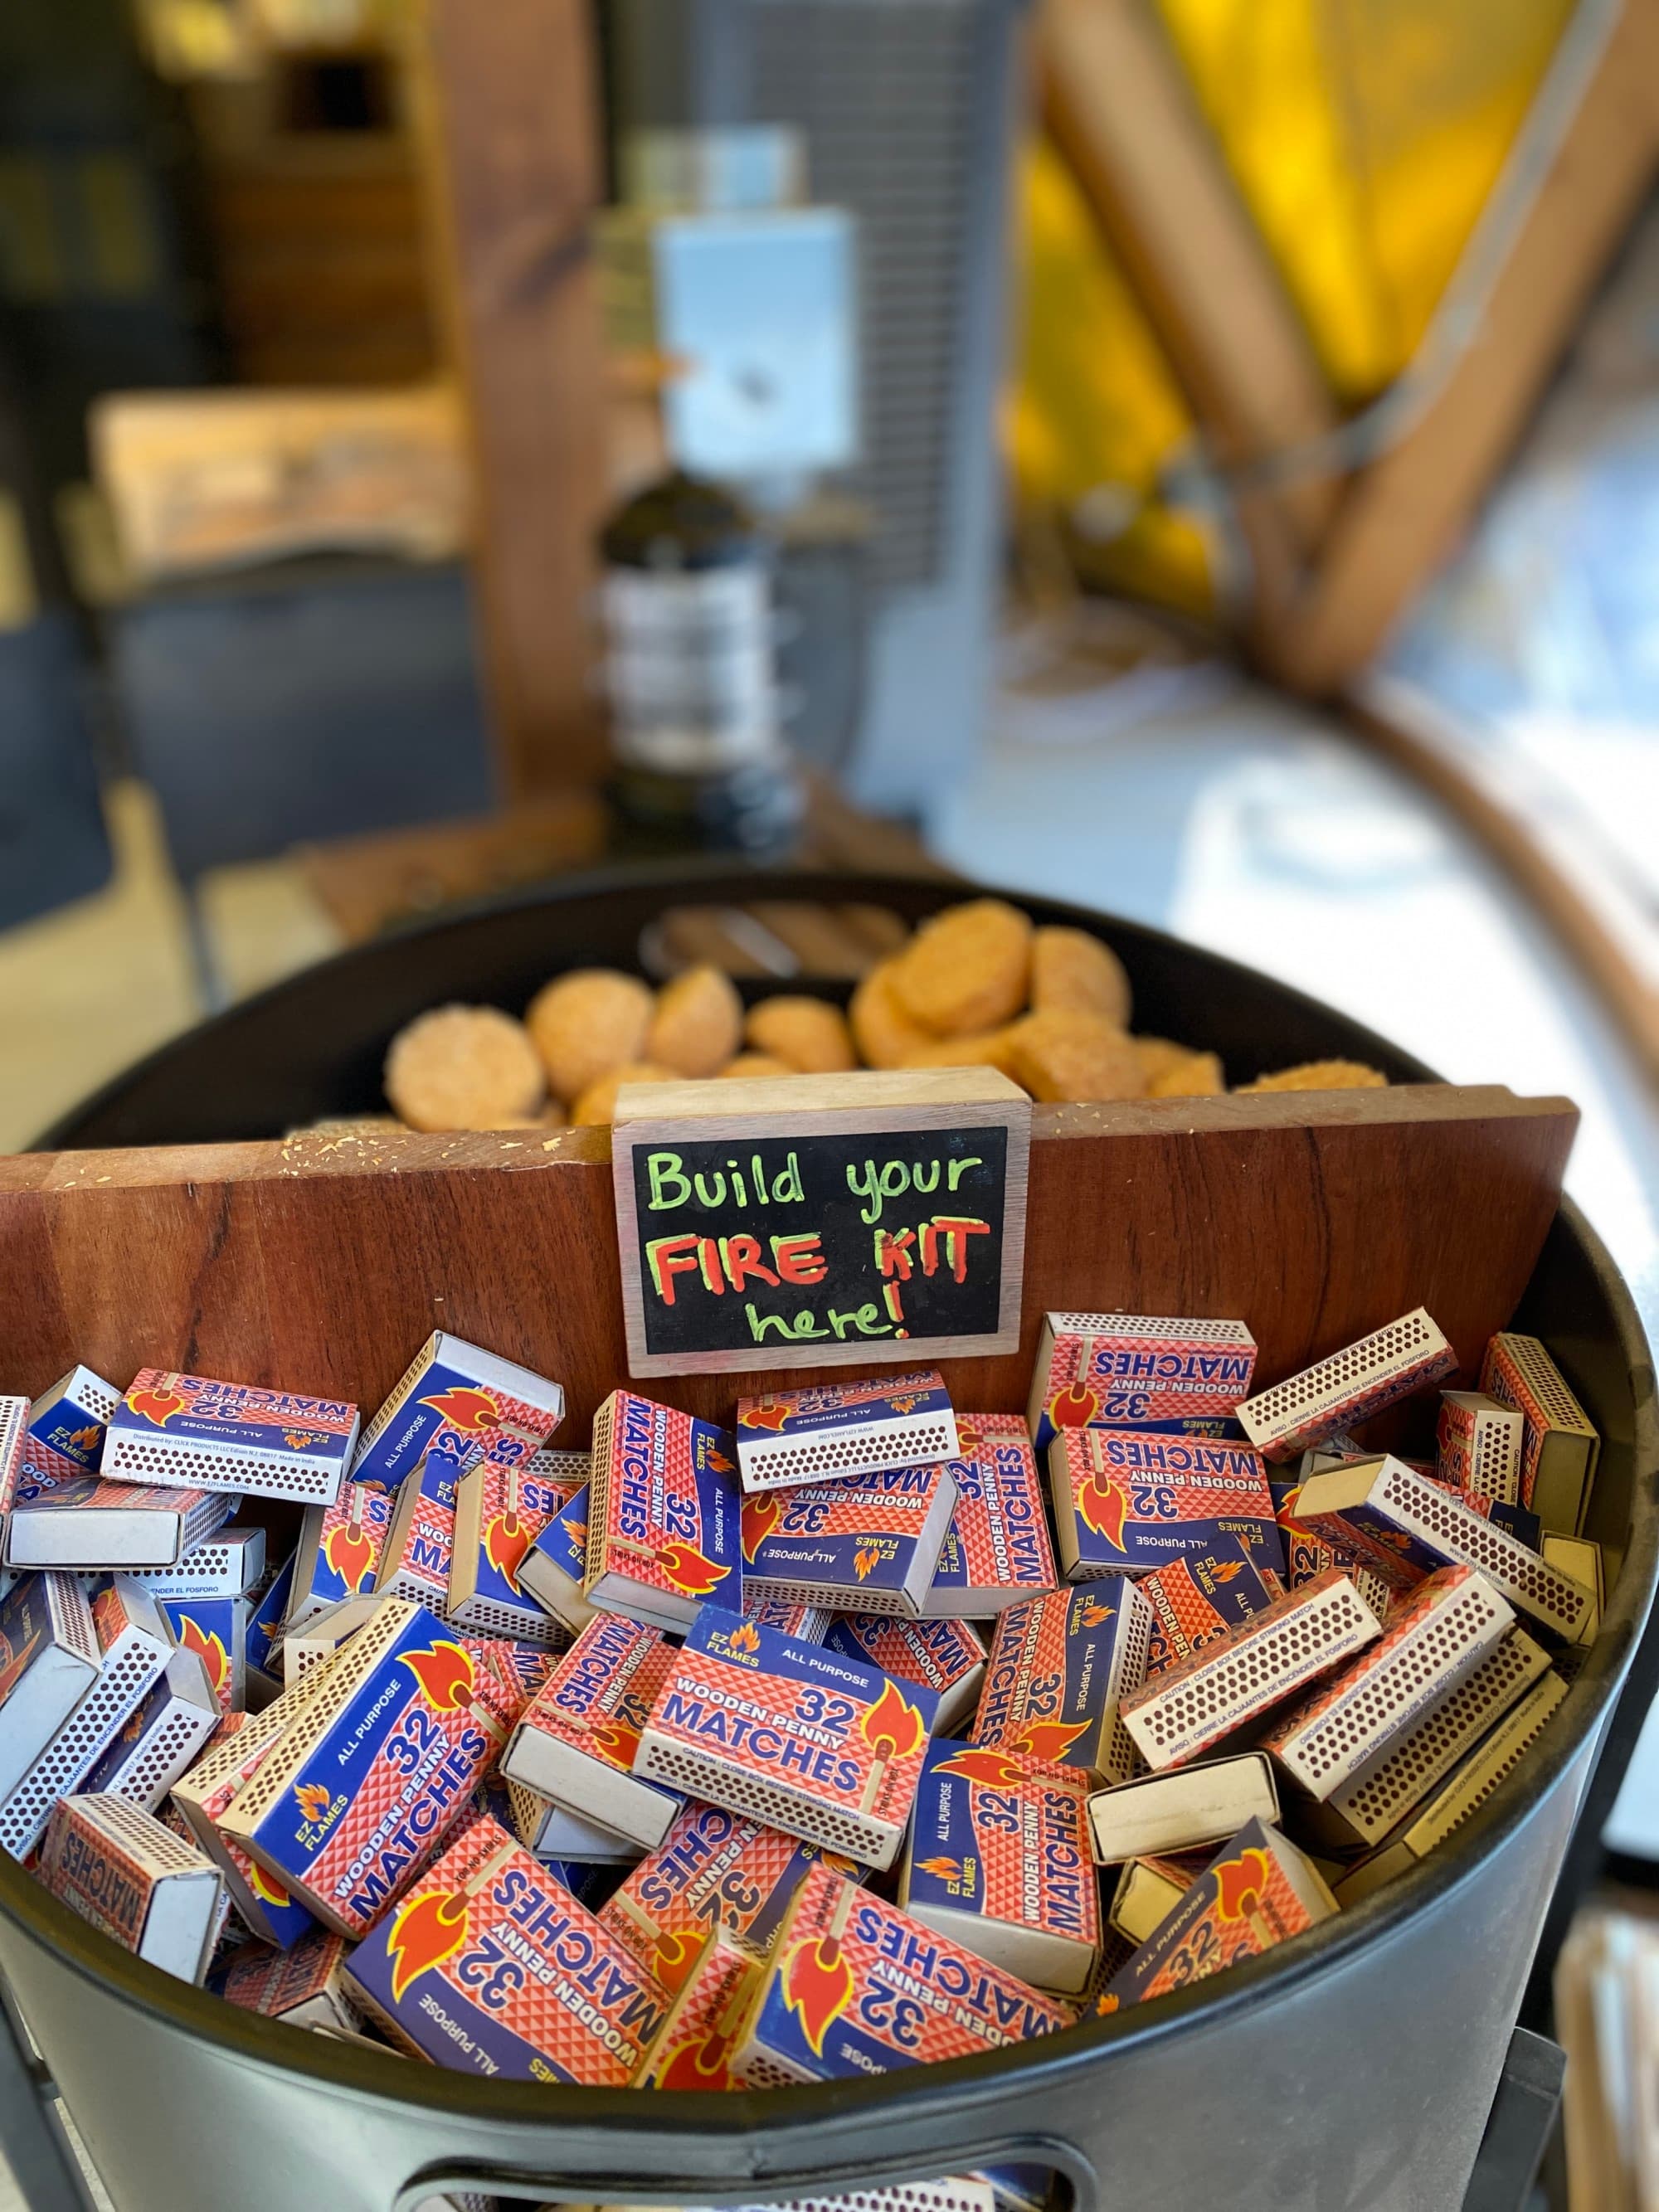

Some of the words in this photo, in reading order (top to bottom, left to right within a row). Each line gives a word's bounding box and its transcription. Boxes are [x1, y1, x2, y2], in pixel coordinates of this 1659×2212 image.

[647, 1151, 805, 1210] Build
[846, 1157, 983, 1224] your
[645, 1232, 828, 1305] FIRE
[873, 1216, 990, 1283] KIT
[746, 1281, 909, 1342] here!
[778, 1370, 932, 1399] MATCHES
[1095, 1352, 1251, 1380] MATCHES
[182, 1378, 348, 1417] MATCHES
[200, 1393, 260, 1410] PENNY
[1110, 1379, 1166, 1391] PENNY
[1171, 1381, 1243, 1394] WOODEN
[191, 1401, 245, 1420] 32
[262, 1403, 345, 1423] WOODEN
[795, 1396, 844, 1412] 32
[795, 1412, 848, 1425] PURPOSE
[1104, 1392, 1151, 1418] 32
[55, 1426, 71, 1438] EZ
[180, 1421, 237, 1434] PURPOSE
[281, 1428, 330, 1437] FLAMES
[385, 1451, 398, 1468] ALL
[395, 1414, 426, 1452] PURPOSE
[706, 1436, 715, 1449] EZ
[1183, 1420, 1225, 1429] FLAMES
[1209, 1430, 1223, 1438] EZ
[47, 1433, 90, 1463] FLAMES
[653, 1410, 667, 1477] WOODEN
[697, 1433, 705, 1471] FLAMES
[1106, 1440, 1259, 1475] MATCHES
[440, 1481, 453, 1491] EZ
[620, 1398, 651, 1539] MATCHES
[1130, 1471, 1186, 1485] PENNY
[1190, 1475, 1262, 1491] WOODEN
[650, 1477, 663, 1529] PENNY
[714, 1488, 724, 1510] ALL
[795, 1489, 849, 1502] PENNY
[852, 1494, 922, 1509] WOODEN
[982, 1464, 1001, 1511] PENNY
[1129, 1485, 1179, 1518] 32
[665, 1493, 697, 1539] 32
[714, 1511, 724, 1554] PURPOSE
[783, 1503, 830, 1532] 32
[996, 1446, 1044, 1582] MATCHES
[1219, 1521, 1262, 1533] FLAMES
[767, 1548, 817, 1561] PURPOSE
[817, 1552, 836, 1563] ALL
[855, 1537, 898, 1549] FLAMES
[880, 1550, 895, 1559] EZ
[950, 1533, 961, 1573] FLAMES
[990, 1511, 1010, 1582] WOODEN
[1136, 1535, 1186, 1547] PURPOSE
[1249, 1534, 1263, 1544] EZ
[939, 1556, 949, 1573] EZ
[1194, 1562, 1216, 1596] FLAMES
[1205, 1556, 1215, 1568] EZ
[1069, 1597, 1084, 1636] FLAMES
[1086, 1594, 1095, 1607] EZ
[1146, 1577, 1177, 1636] WOODEN
[1235, 1592, 1249, 1610] ALL
[711, 1631, 729, 1643] EZ
[1021, 1602, 1045, 1668] WOODEN
[1158, 1680, 1191, 1704] CAUTION
[1192, 1663, 1217, 1682] CLOSE
[1215, 1653, 1233, 1668] BOX
[1230, 1636, 1260, 1658] BEFORE
[1258, 1617, 1291, 1641] STRIKING
[1289, 1602, 1316, 1621] MATCH
[1455, 1639, 1484, 1668] CAUTION
[556, 1621, 635, 1714] MATCHES
[617, 1636, 654, 1680] WOODEN
[707, 1641, 760, 1668] FLAMES
[782, 1649, 805, 1665] ALL
[810, 1659, 869, 1688] PURPOSE
[903, 1629, 944, 1689] WOODEN
[1081, 1644, 1095, 1665] ALL
[980, 1605, 1029, 1748] MATCHES
[1010, 1668, 1031, 1722] PENNY
[1076, 1664, 1092, 1711] PURPOSE
[1167, 1738, 1190, 1756] AVISO
[1192, 1719, 1219, 1740] CIERRE
[1216, 1714, 1228, 1724] LA
[1267, 1681, 1279, 1694] DE
[1277, 1659, 1316, 1686] ENCENDER
[1314, 1653, 1326, 1664] EL
[1323, 1632, 1359, 1658] FOSFORO
[1418, 1686, 1434, 1703] BOX
[1431, 1666, 1454, 1690] CLOSE
[597, 1678, 627, 1715] PENNY
[615, 1694, 650, 1731] 32
[676, 1677, 767, 1722] WOODEN
[772, 1715, 845, 1751] PENNY
[795, 1689, 856, 1736] 32
[1024, 1674, 1061, 1719] 32
[1394, 1698, 1421, 1725] BEFORE
[337, 1743, 358, 1767] ALL
[355, 1678, 402, 1738] PURPOSE
[1366, 1720, 1397, 1751] STRIKING
[14, 1834, 32, 1857] AVISO
[88, 1743, 100, 1757] DE
[95, 1706, 129, 1745] ENCENDER
[124, 1696, 135, 1709] EL
[130, 1665, 159, 1699] FOSFORO
[386, 1708, 441, 1777] 32
[663, 1694, 861, 1792] MATCHES
[1345, 1747, 1370, 1772] MATCH
[334, 1805, 405, 1899] WOODEN
[403, 1732, 451, 1806] PENNY
[937, 1782, 952, 1821] PURPOSE
[978, 1791, 1020, 1834] 32
[294, 1824, 314, 1844] EZ
[304, 1793, 349, 1853] FLAMES
[348, 1728, 487, 1921] MATCHES
[937, 1824, 949, 1841] ALL
[1024, 1801, 1040, 1850] PENNY
[476, 1833, 503, 1858] STRIKE
[1045, 1792, 1082, 1932] MATCHES
[61, 1830, 143, 1932] MATCHES
[453, 1866, 470, 1883] BOX
[686, 1839, 745, 1911] PENNY
[947, 1881, 960, 1894] EZ
[962, 1857, 976, 1898] FLAMES
[1024, 1853, 1040, 1921] WOODEN
[1135, 1952, 1156, 1976] ALL
[1157, 1891, 1206, 1952] PURPOSE
[490, 1920, 558, 1986] PENNY
[493, 1869, 665, 2046] MATCHES
[1169, 1920, 1219, 1987] 32
[457, 1934, 525, 2010] 32
[872, 1958, 951, 2011] PENNY
[418, 1992, 475, 2055] PURPOSE
[553, 1980, 639, 2068] WOODEN
[859, 1975, 927, 2049] 32
[470, 2047, 500, 2076] ALL
